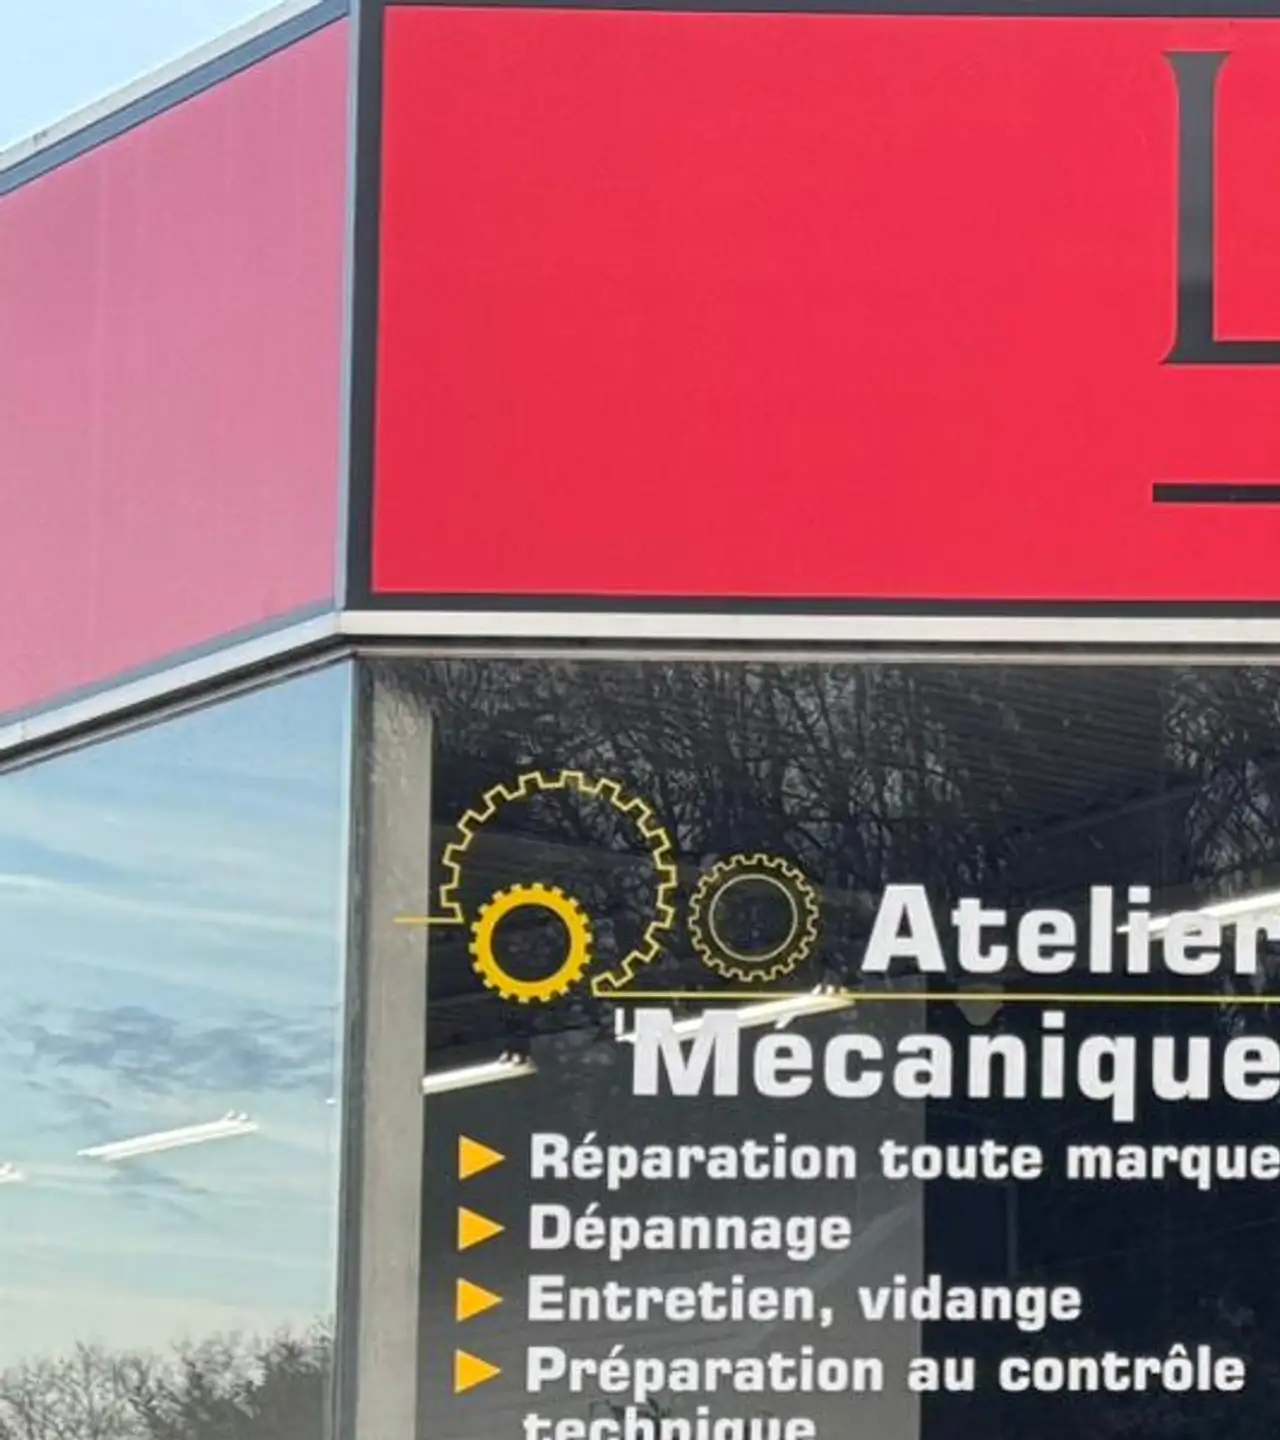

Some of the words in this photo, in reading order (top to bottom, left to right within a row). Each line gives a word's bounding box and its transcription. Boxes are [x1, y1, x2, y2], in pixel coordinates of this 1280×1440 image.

[531, 1131, 857, 1190] Réparation
[879, 1140, 1042, 1179] toute
[1067, 1145, 1280, 1190] marque
[530, 1202, 851, 1261] Dépannage
[528, 1274, 833, 1328] Entretien,
[858, 1274, 1081, 1331] vidange
[526, 1344, 883, 1403] Préparation
[907, 1357, 974, 1392] au
[1000, 1343, 1245, 1392] contrôle
